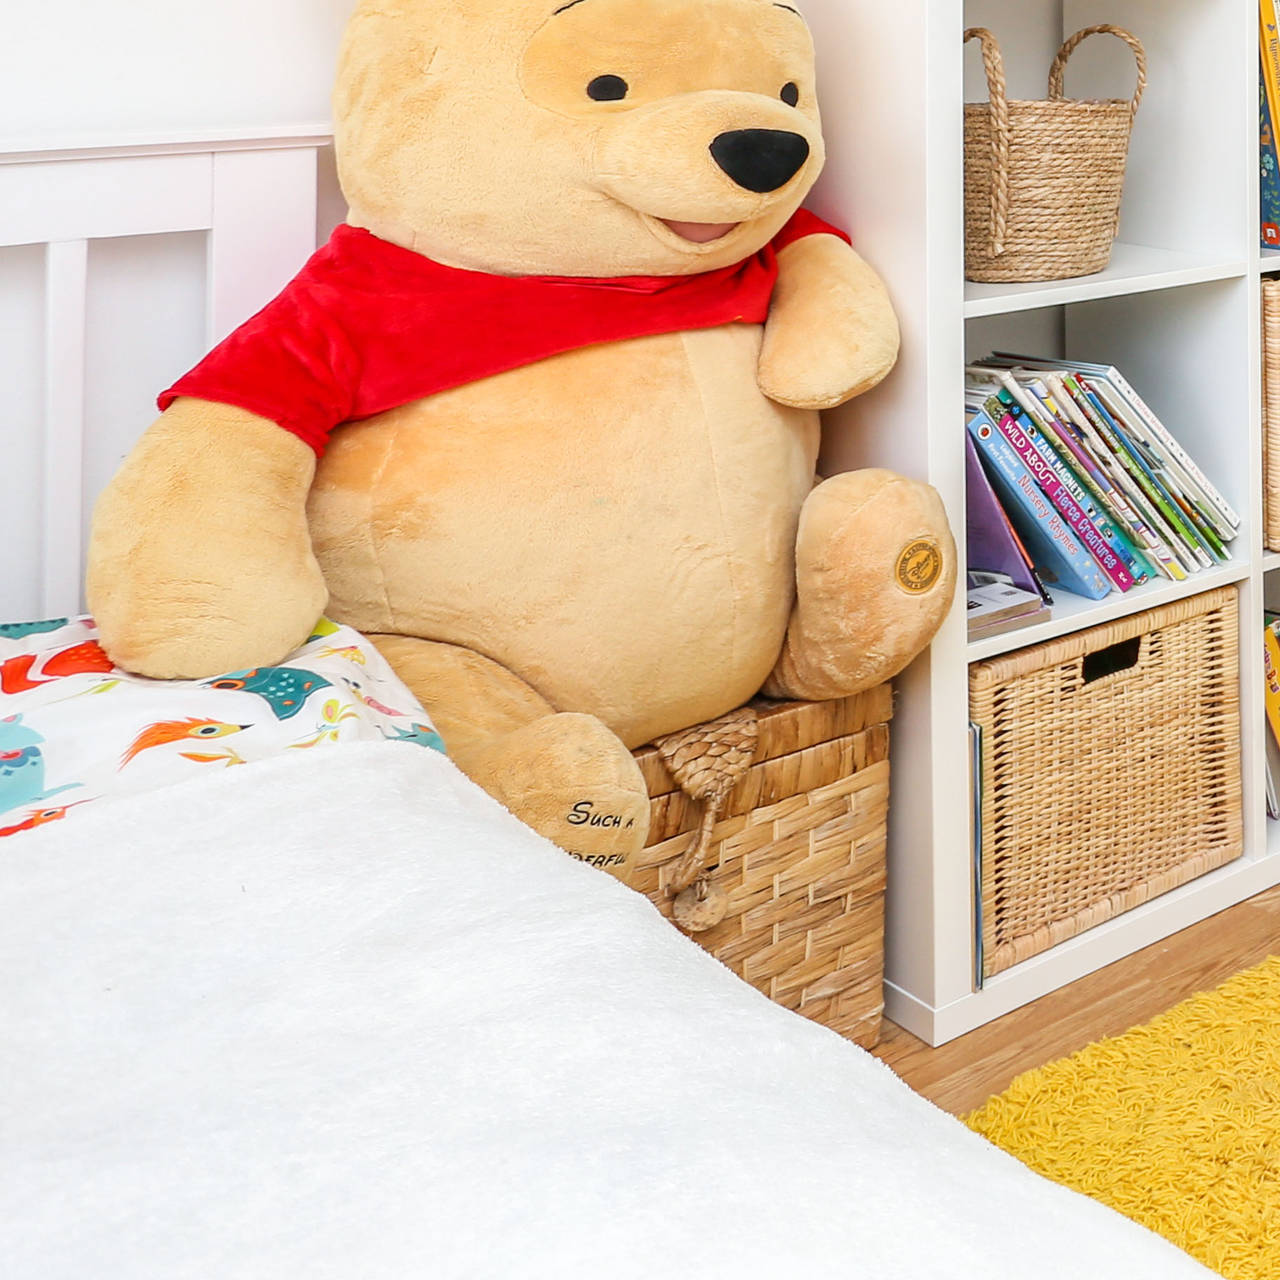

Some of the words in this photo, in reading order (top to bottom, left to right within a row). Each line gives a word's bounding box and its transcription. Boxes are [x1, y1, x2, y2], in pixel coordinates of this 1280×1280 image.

[1004, 420, 1026, 449] WILD
[1023, 448, 1057, 487] ABOUT
[1079, 519, 1117, 569] Creatures
[1036, 438, 1058, 465] FARM
[1052, 460, 1086, 501] MAGNETS
[1017, 474, 1050, 519] Nursery
[1048, 514, 1079, 556] Rhymes
